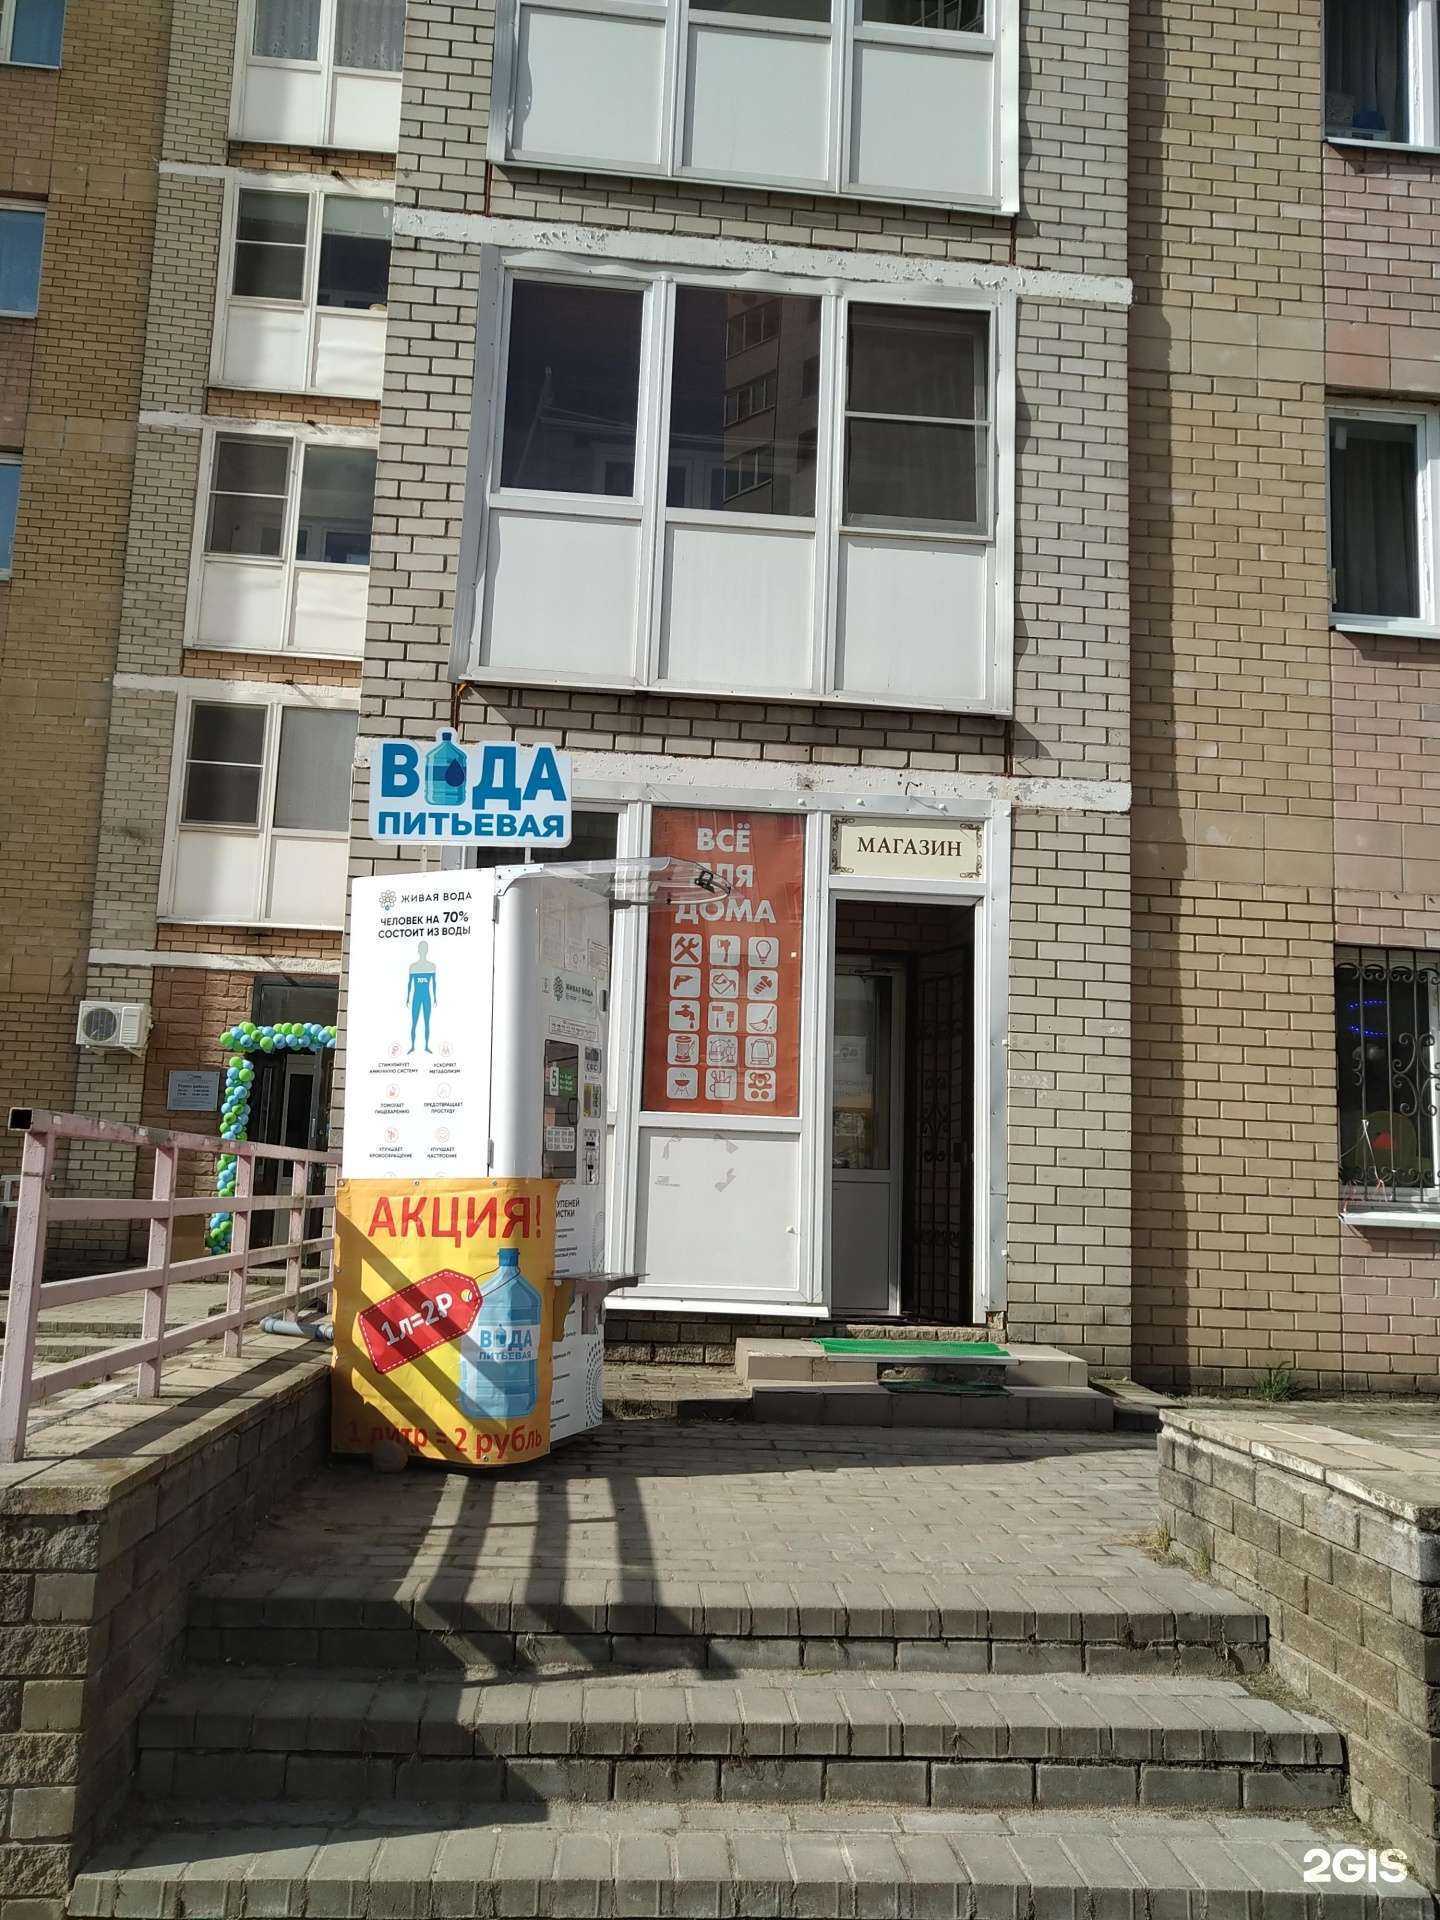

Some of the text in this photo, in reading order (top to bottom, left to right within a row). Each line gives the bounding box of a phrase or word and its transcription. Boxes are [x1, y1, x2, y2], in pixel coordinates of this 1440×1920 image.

[378, 811, 564, 837] ПИТЬЕВАЯ
[697, 822, 751, 852] ВСЁ
[857, 836, 962, 857] МАГАЗИН
[401, 891, 472, 903] ЖИВАЯ ВОДА
[380, 910, 469, 926] ЧЕЛОВЕК НА 70%
[674, 898, 777, 924] ДОМА
[378, 925, 471, 938] СОСТОИТ ИЗ ВОДЫ
[367, 1195, 543, 1248] АКЦИЯ!
[479, 1350, 532, 1361] ПИТЬЕВАЯ
[454, 1427, 468, 1453] 2
[475, 1424, 543, 1460] рубль
